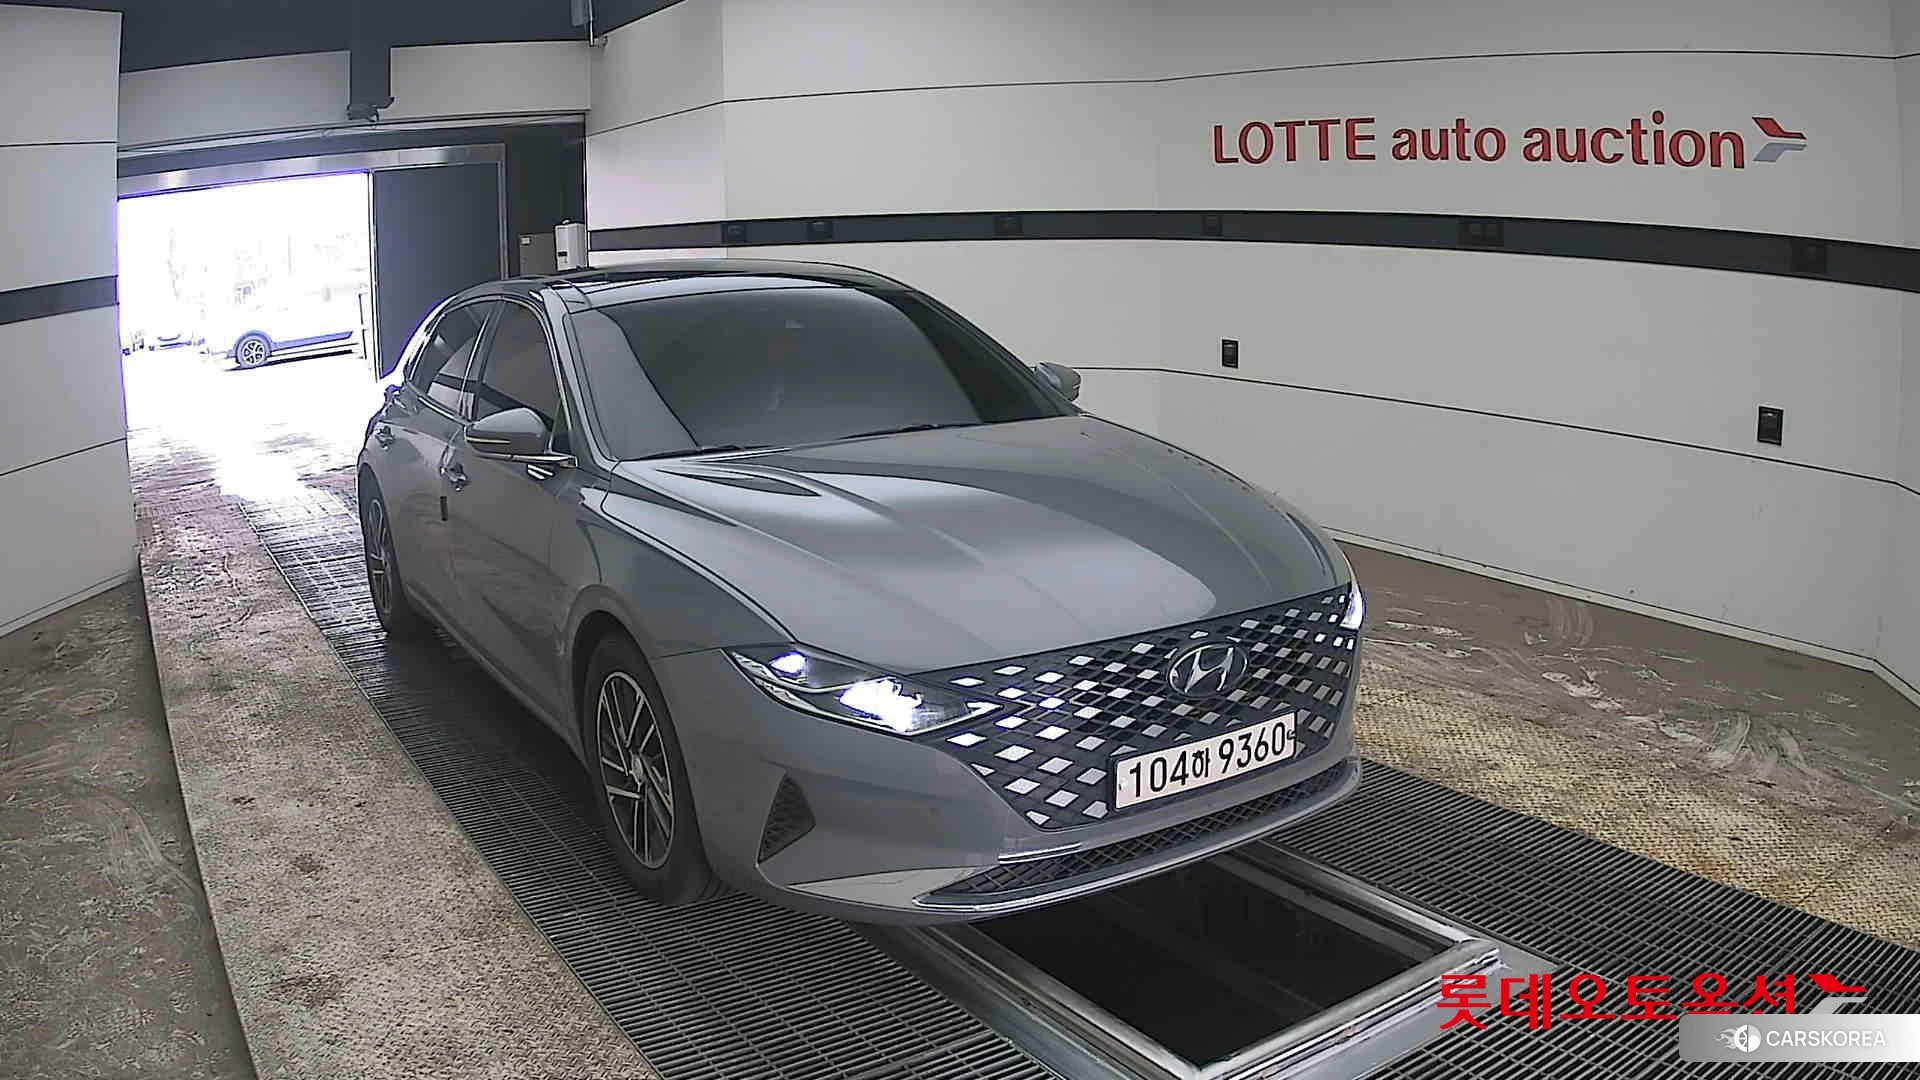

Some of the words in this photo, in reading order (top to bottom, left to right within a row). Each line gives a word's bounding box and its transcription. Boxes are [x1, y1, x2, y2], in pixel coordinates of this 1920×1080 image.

[1213, 117, 1376, 164] LOTTE
[1391, 118, 1506, 162] auto
[1522, 111, 1745, 169] auction
[1129, 747, 1211, 798] 104하
[1218, 721, 1286, 774] 9360
